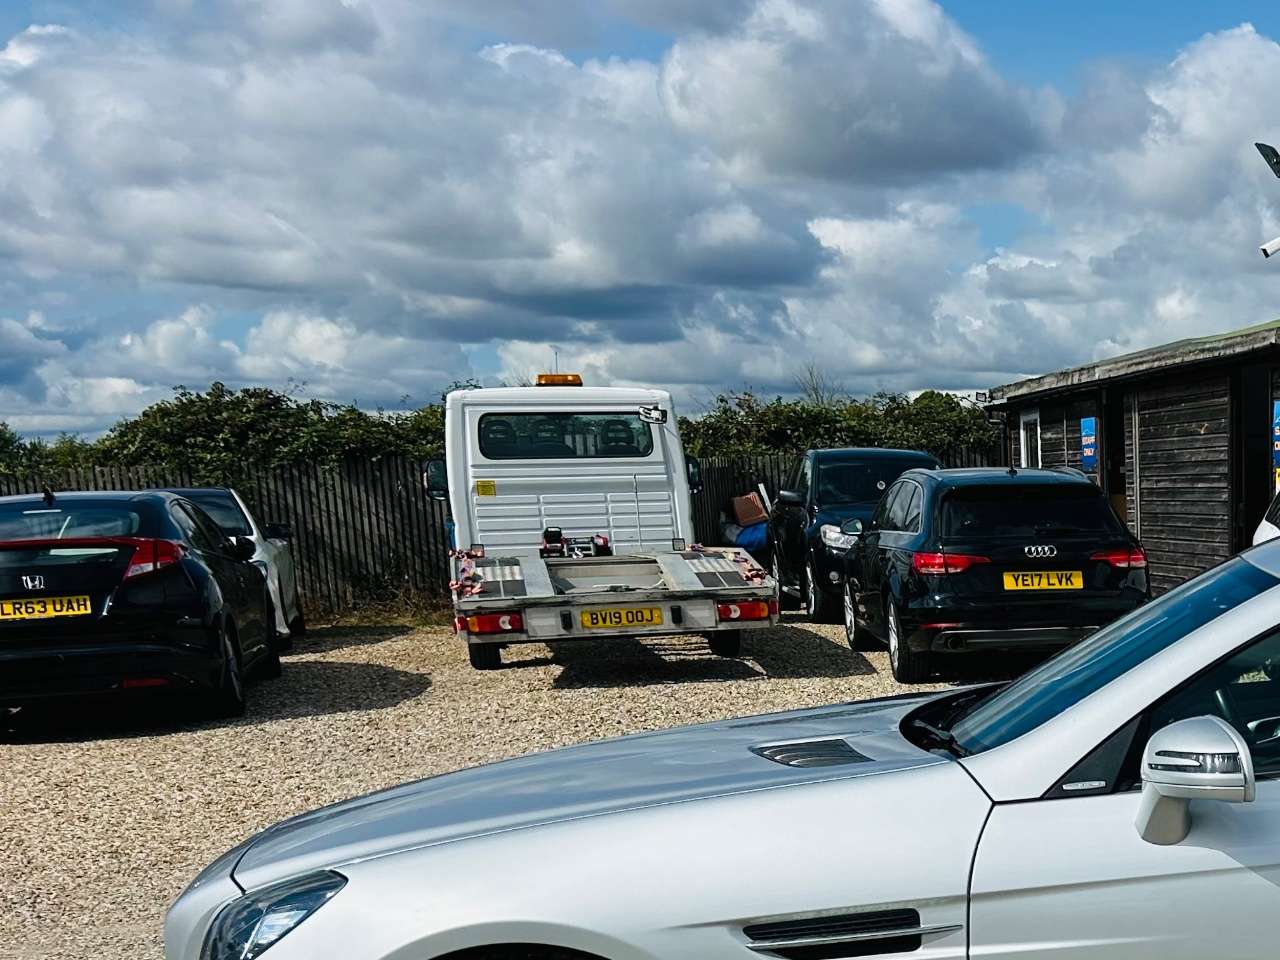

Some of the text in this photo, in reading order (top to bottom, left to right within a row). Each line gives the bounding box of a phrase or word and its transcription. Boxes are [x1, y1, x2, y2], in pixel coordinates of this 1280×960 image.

[1012, 572, 1074, 587] YE17 LVK
[0, 598, 88, 616] LR63 UAH
[590, 611, 622, 625] BV19
